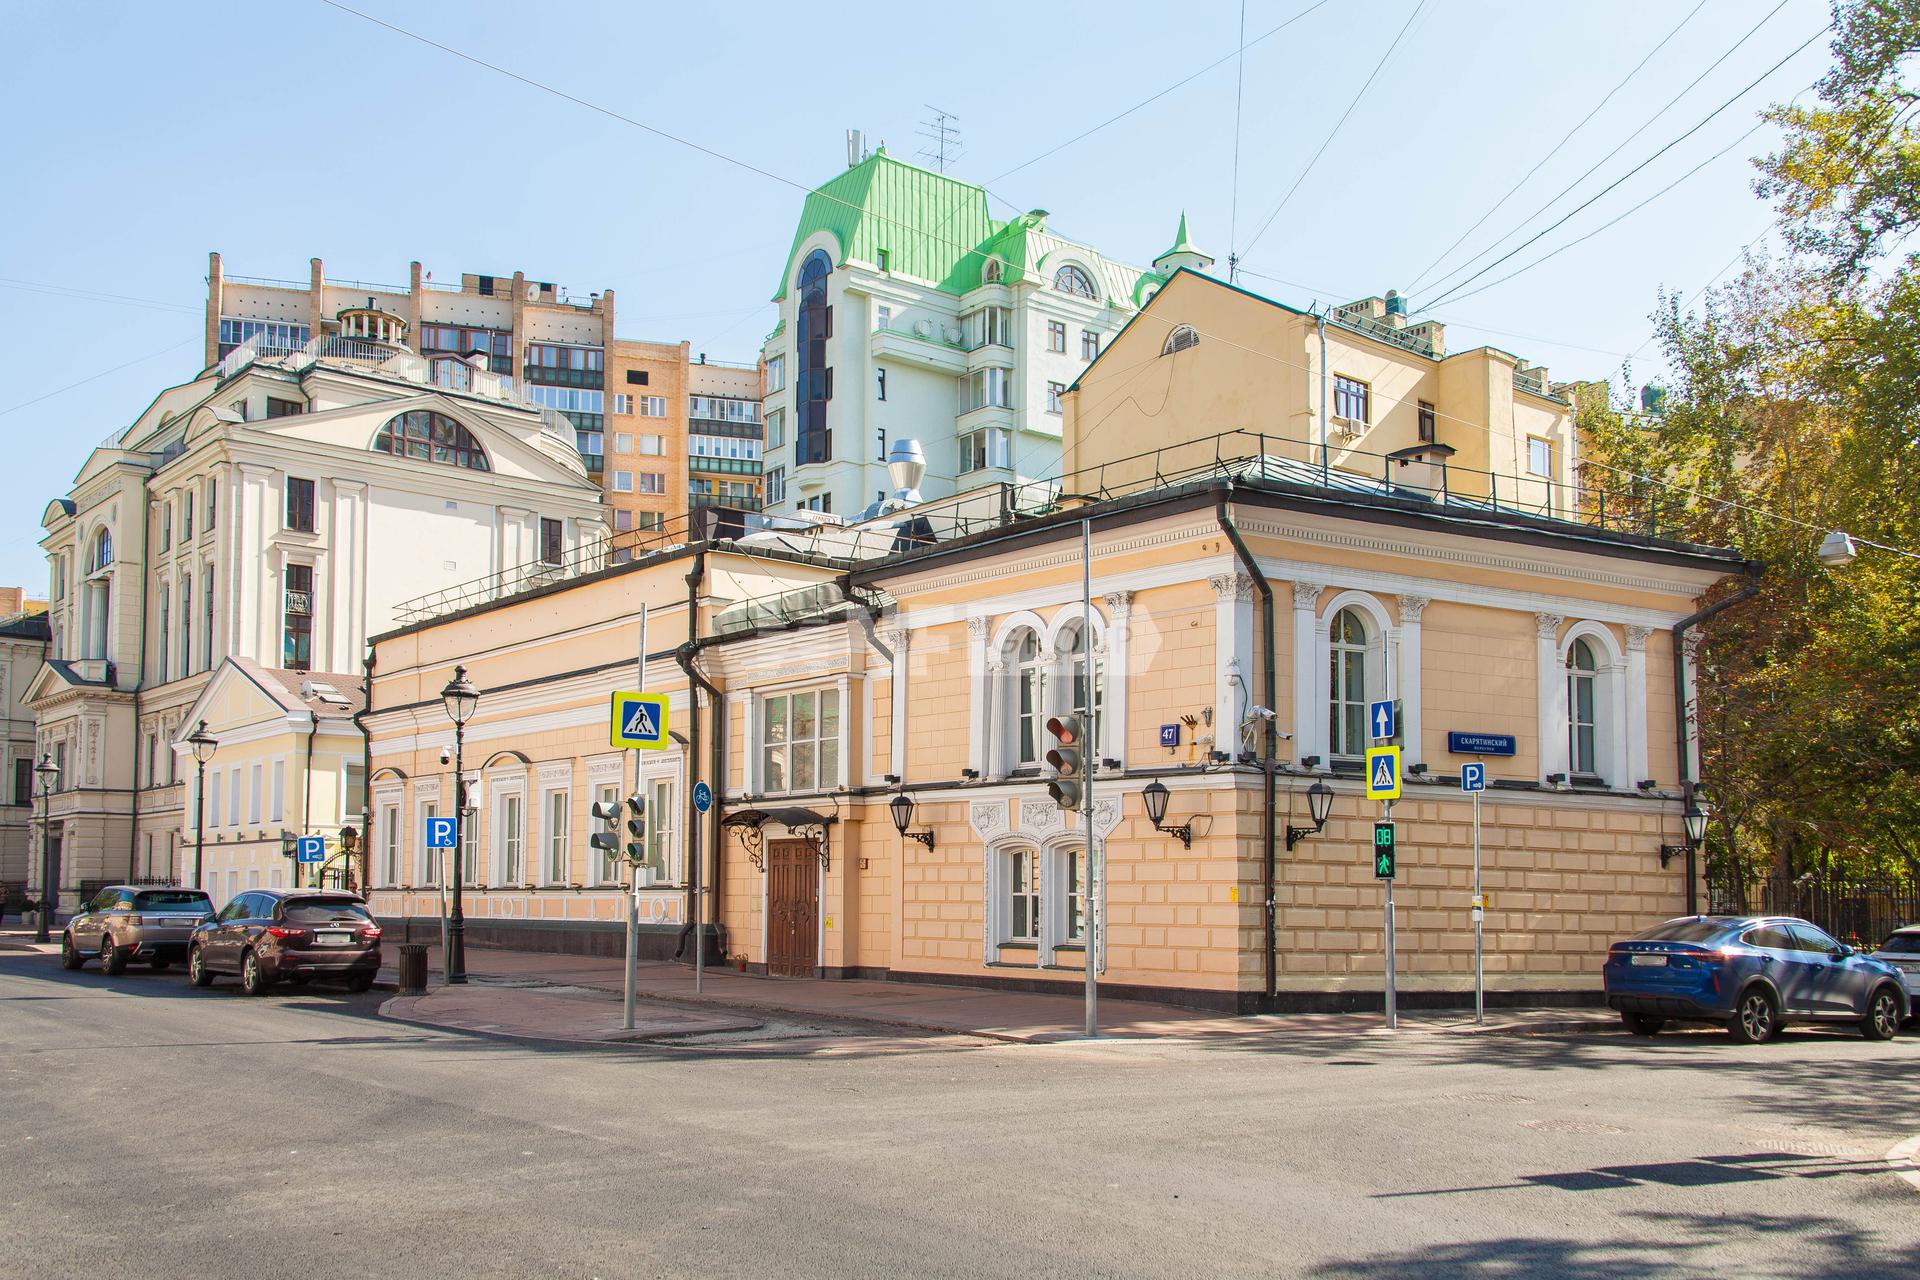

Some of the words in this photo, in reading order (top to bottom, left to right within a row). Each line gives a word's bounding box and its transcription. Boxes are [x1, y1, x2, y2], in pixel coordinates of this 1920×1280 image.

[1162, 728, 1174, 740] 47
[1460, 737, 1507, 747] СКАРЯТИНСКИЙ
[1466, 766, 1480, 790] P
[435, 821, 451, 845] P
[1376, 829, 1391, 845] 08
[305, 840, 320, 860] P
